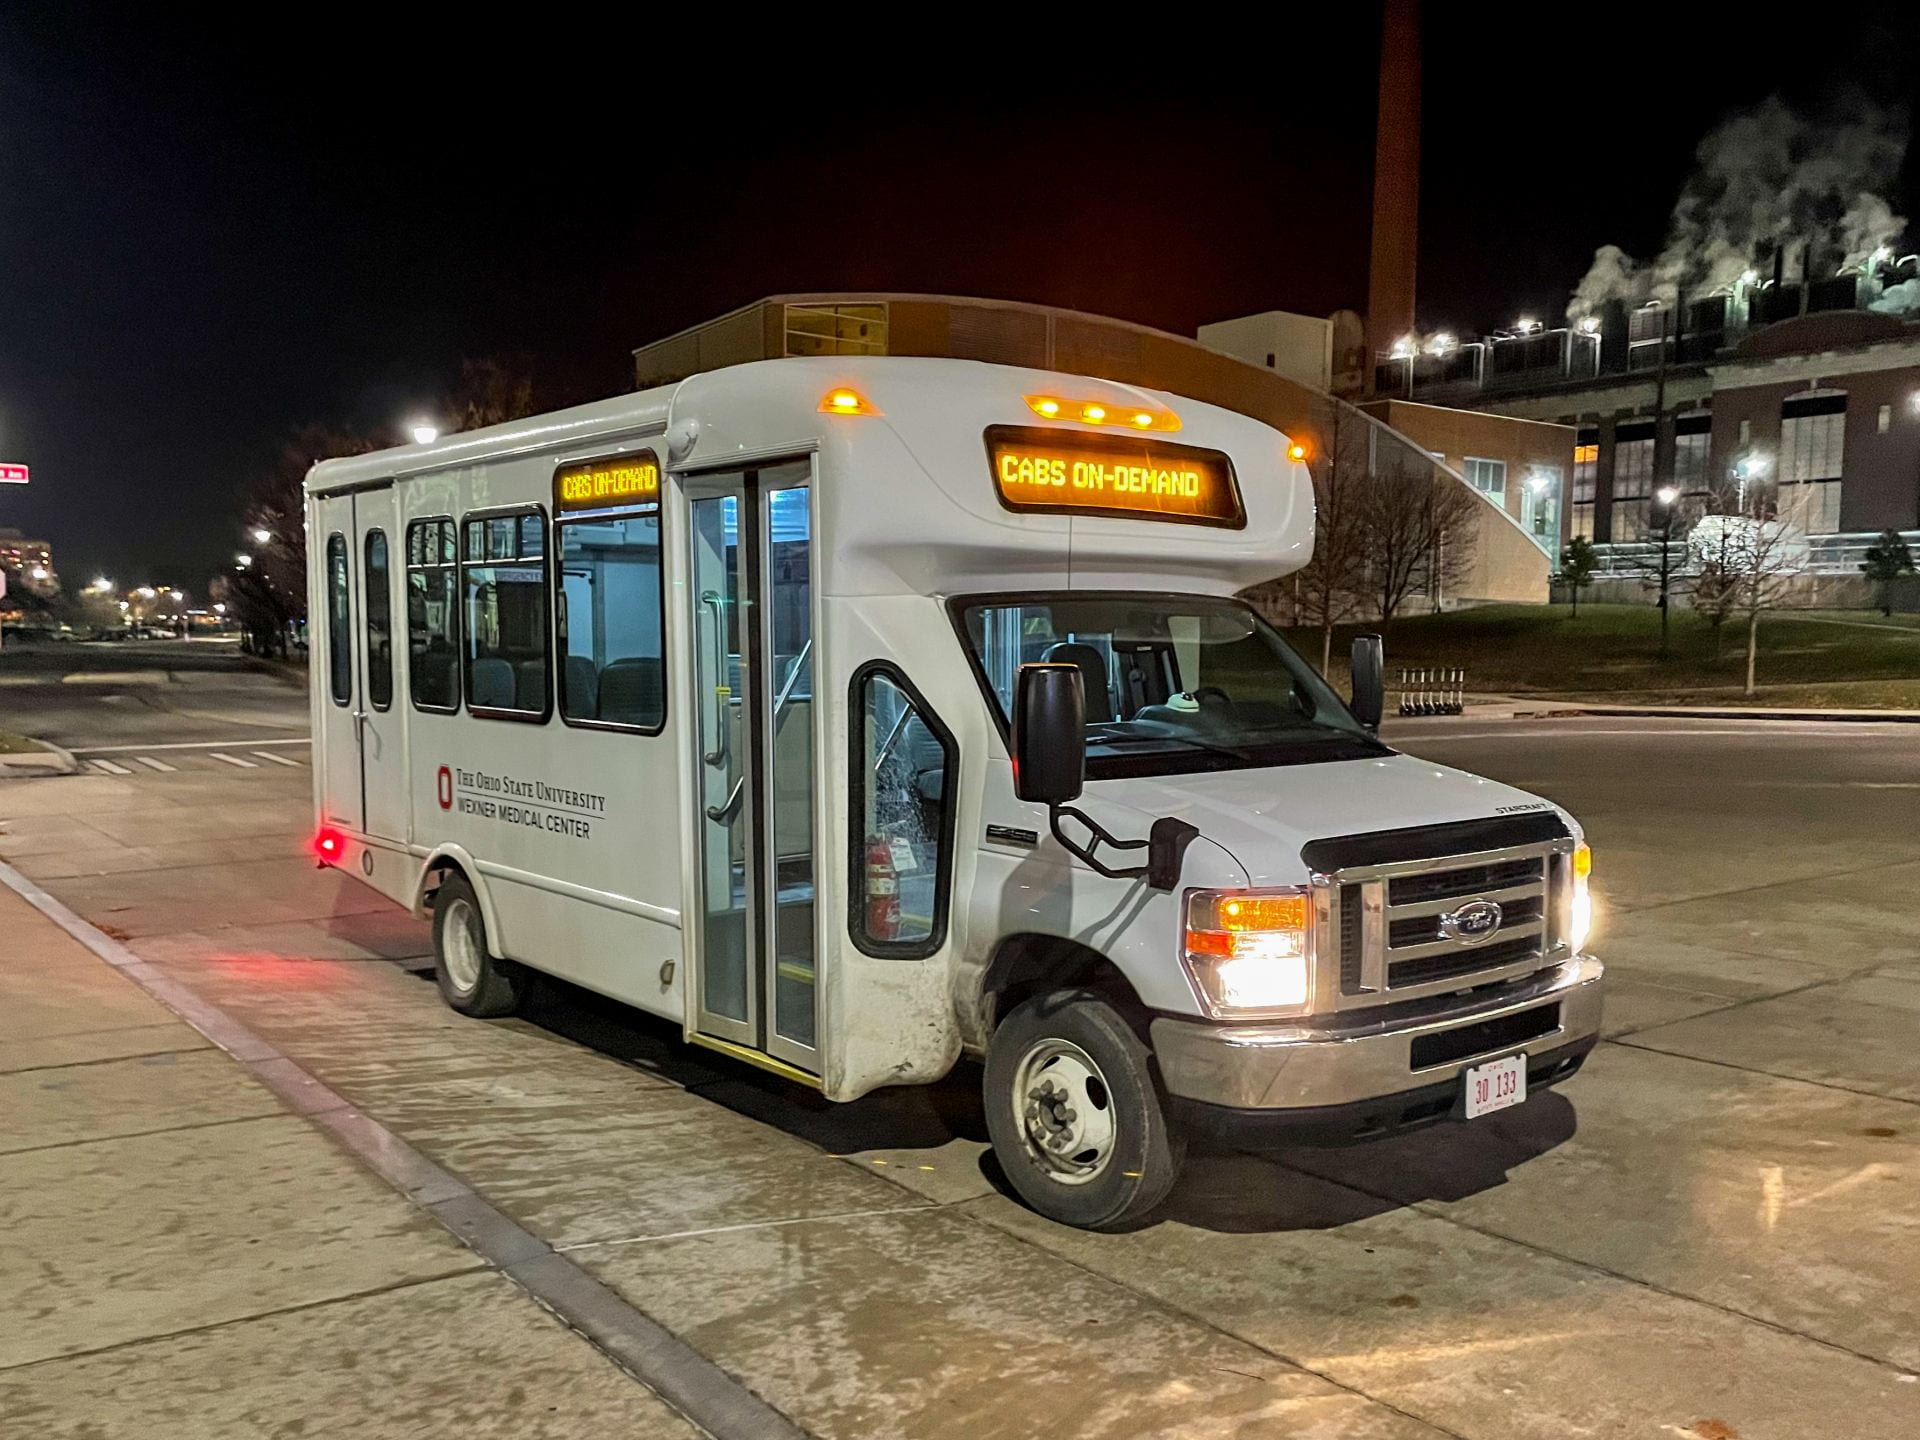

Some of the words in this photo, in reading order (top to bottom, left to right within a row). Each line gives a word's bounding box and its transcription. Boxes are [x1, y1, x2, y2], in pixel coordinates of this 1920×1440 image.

[563, 474, 592, 500] CABS
[594, 465, 657, 495] ON-DEMAND
[1001, 455, 1066, 487] CABS
[1073, 462, 1198, 496] ON-DEMAND
[457, 797, 497, 818] WEXNER
[499, 805, 544, 830] MEDICAL
[546, 814, 590, 840] CENTER
[1476, 1078, 1489, 1105] 30
[1496, 1070, 1517, 1098] 133
